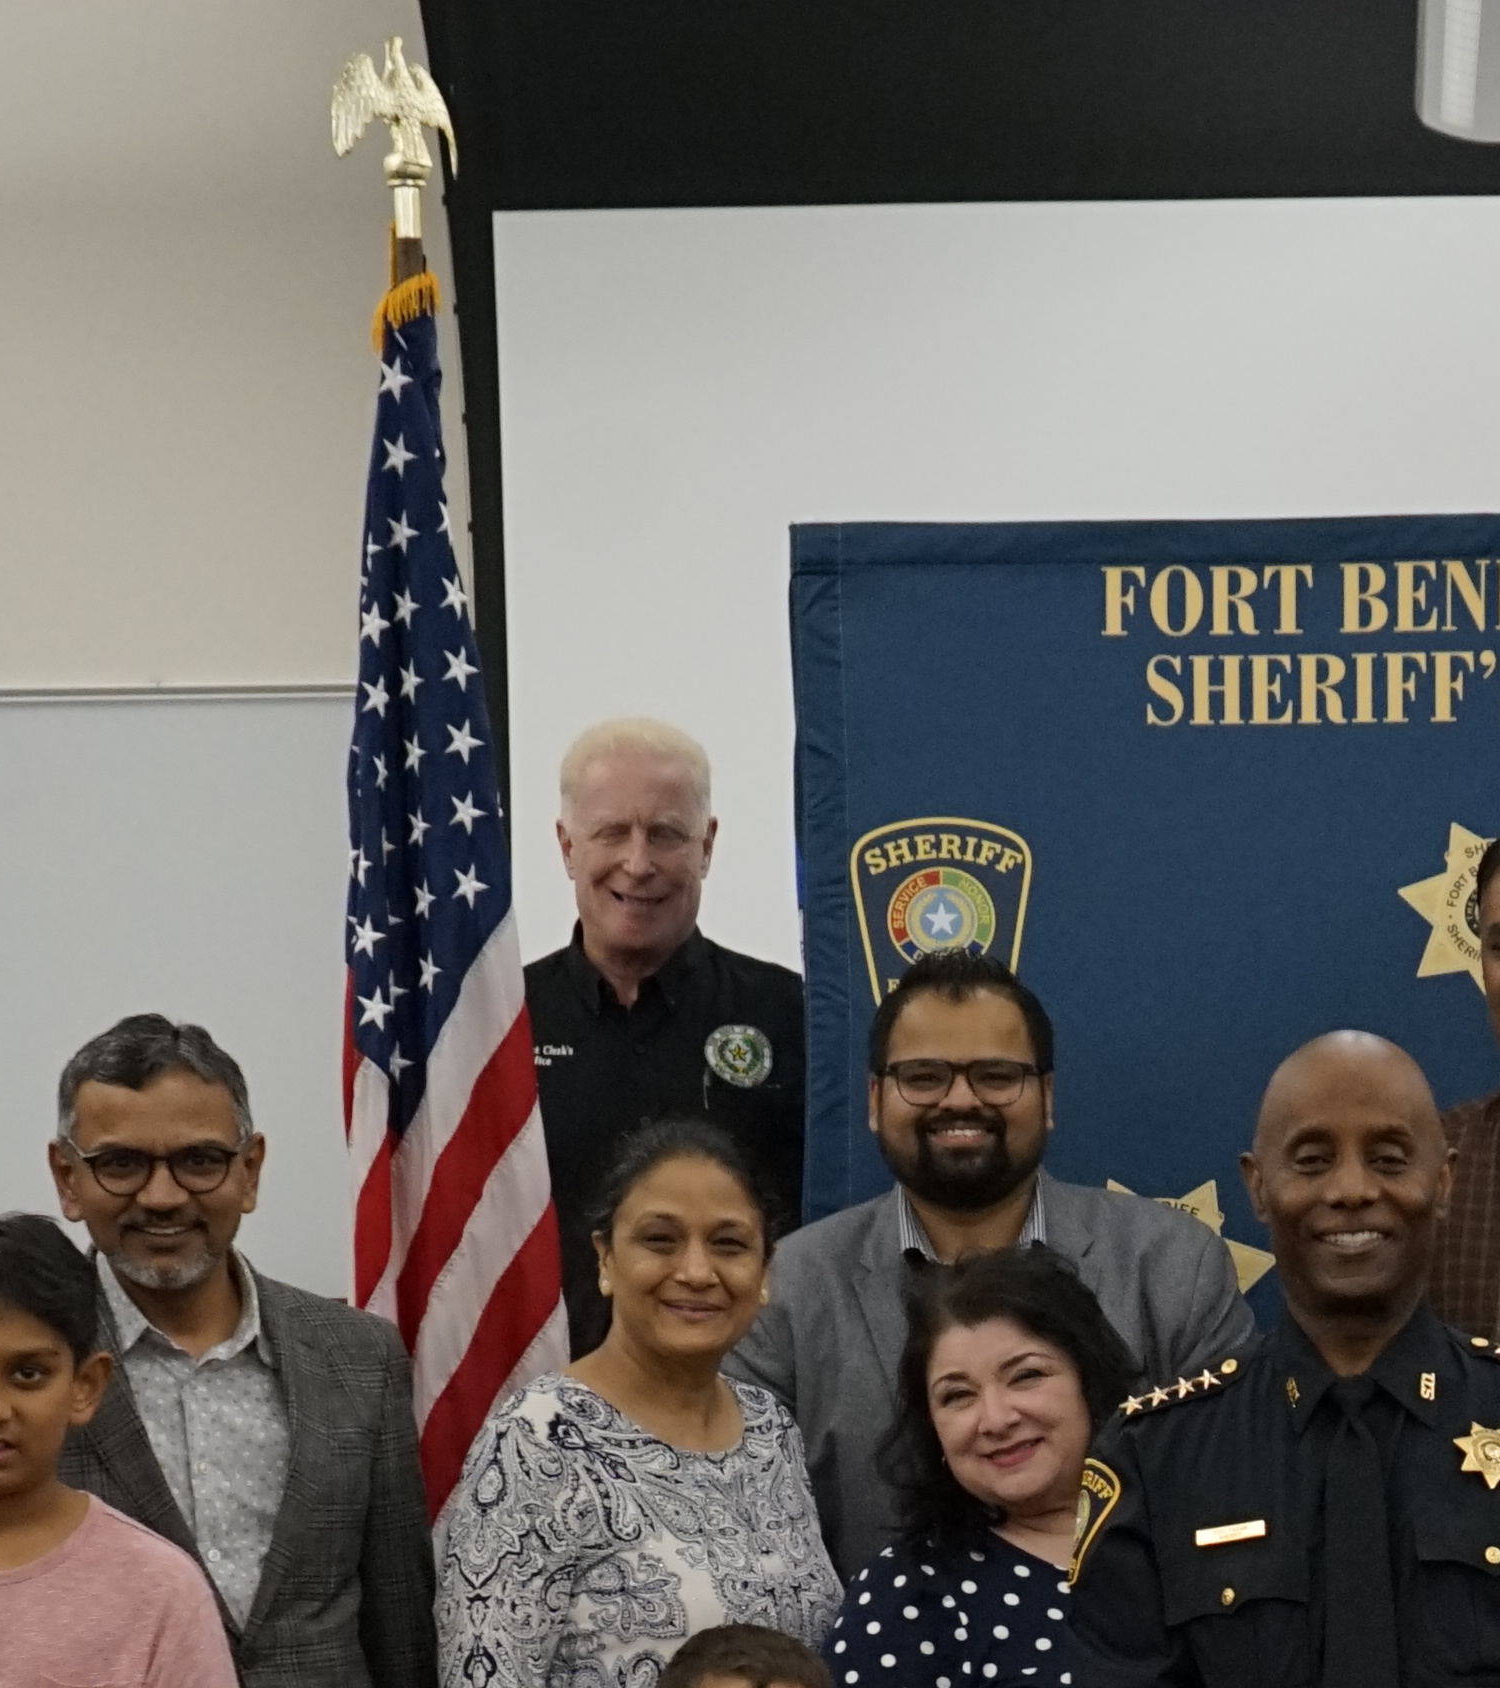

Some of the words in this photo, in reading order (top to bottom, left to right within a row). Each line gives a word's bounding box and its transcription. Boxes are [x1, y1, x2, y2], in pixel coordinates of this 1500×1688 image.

[1101, 565, 1313, 637] FORT
[864, 833, 1023, 875] SHERIFF
[893, 876, 928, 929] SERVICE
[958, 879, 991, 925] HONOR
[1446, 873, 1469, 908] FORT
[1082, 1469, 1113, 1499] RIFF
